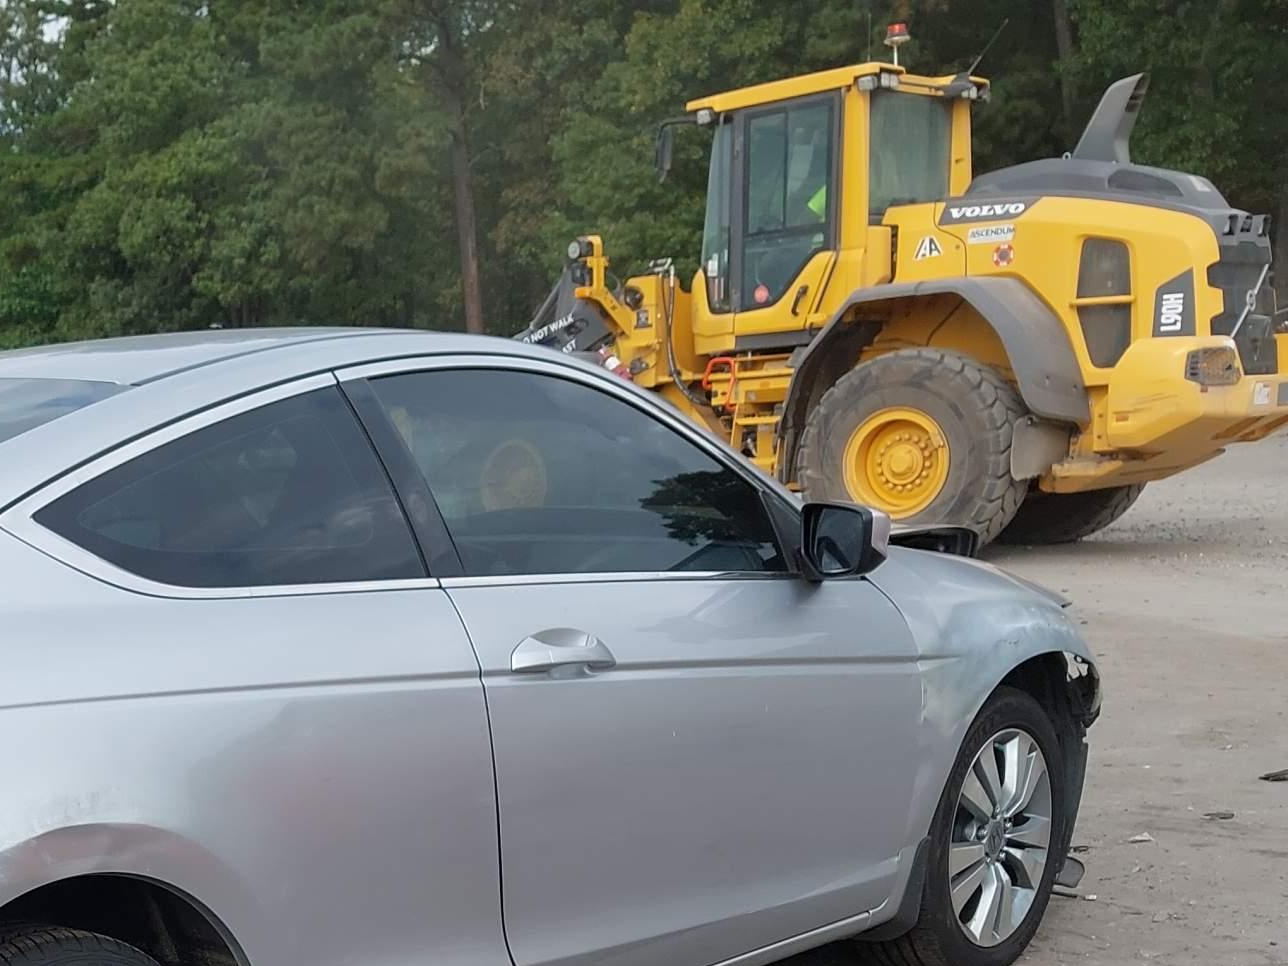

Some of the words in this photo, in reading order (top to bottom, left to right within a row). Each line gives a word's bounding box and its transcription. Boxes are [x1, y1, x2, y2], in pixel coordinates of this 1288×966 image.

[950, 203, 1025, 219] VOLVO
[970, 227, 1015, 239] ASCENDUM
[1160, 293, 1184, 332] L90H
[531, 326, 548, 343] NOT
[549, 312, 575, 333] WALK
[562, 339, 577, 353] AST
